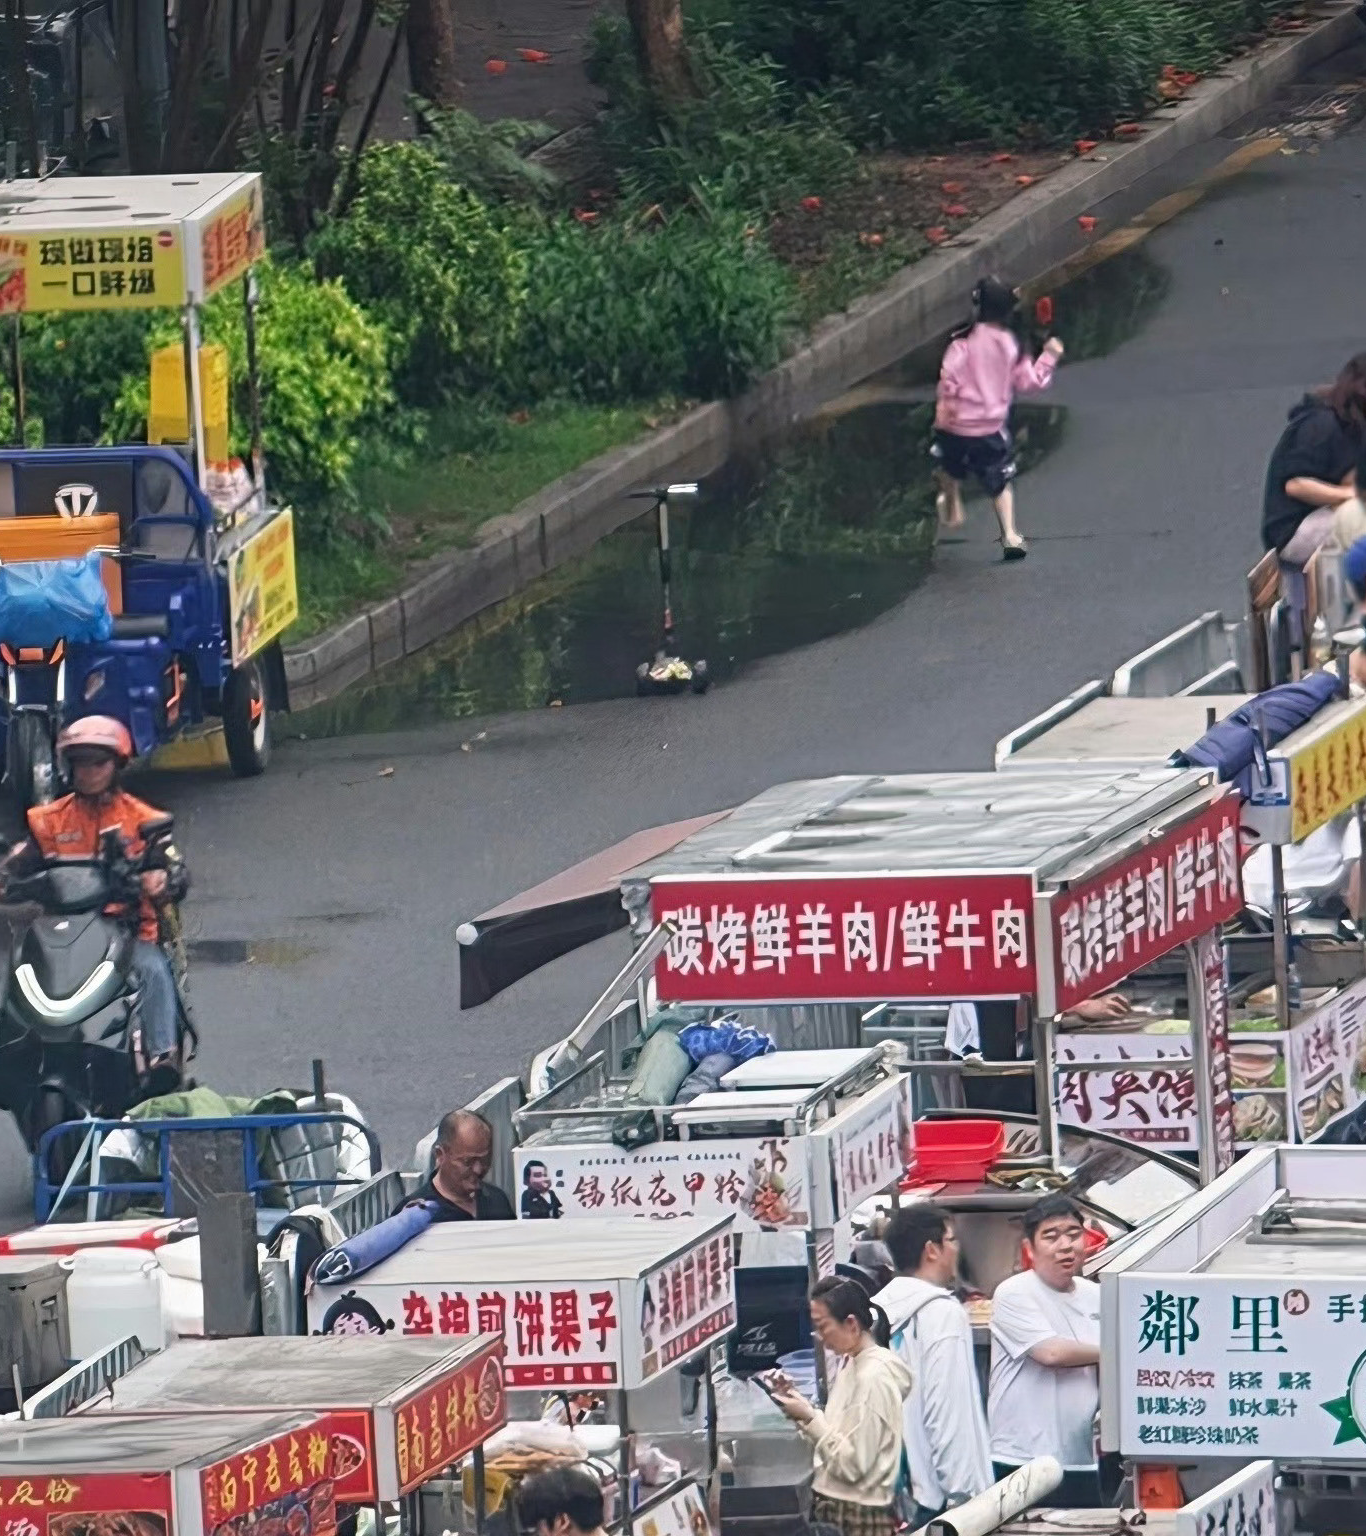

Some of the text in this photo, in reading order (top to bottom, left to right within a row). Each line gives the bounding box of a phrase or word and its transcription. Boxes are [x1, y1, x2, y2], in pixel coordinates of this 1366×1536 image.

[661, 897, 1029, 975] 碳烤鲜羊肉/鲜牛肉
[1059, 816, 1238, 988] 碳烤鲜羊肉/鲜牛肉
